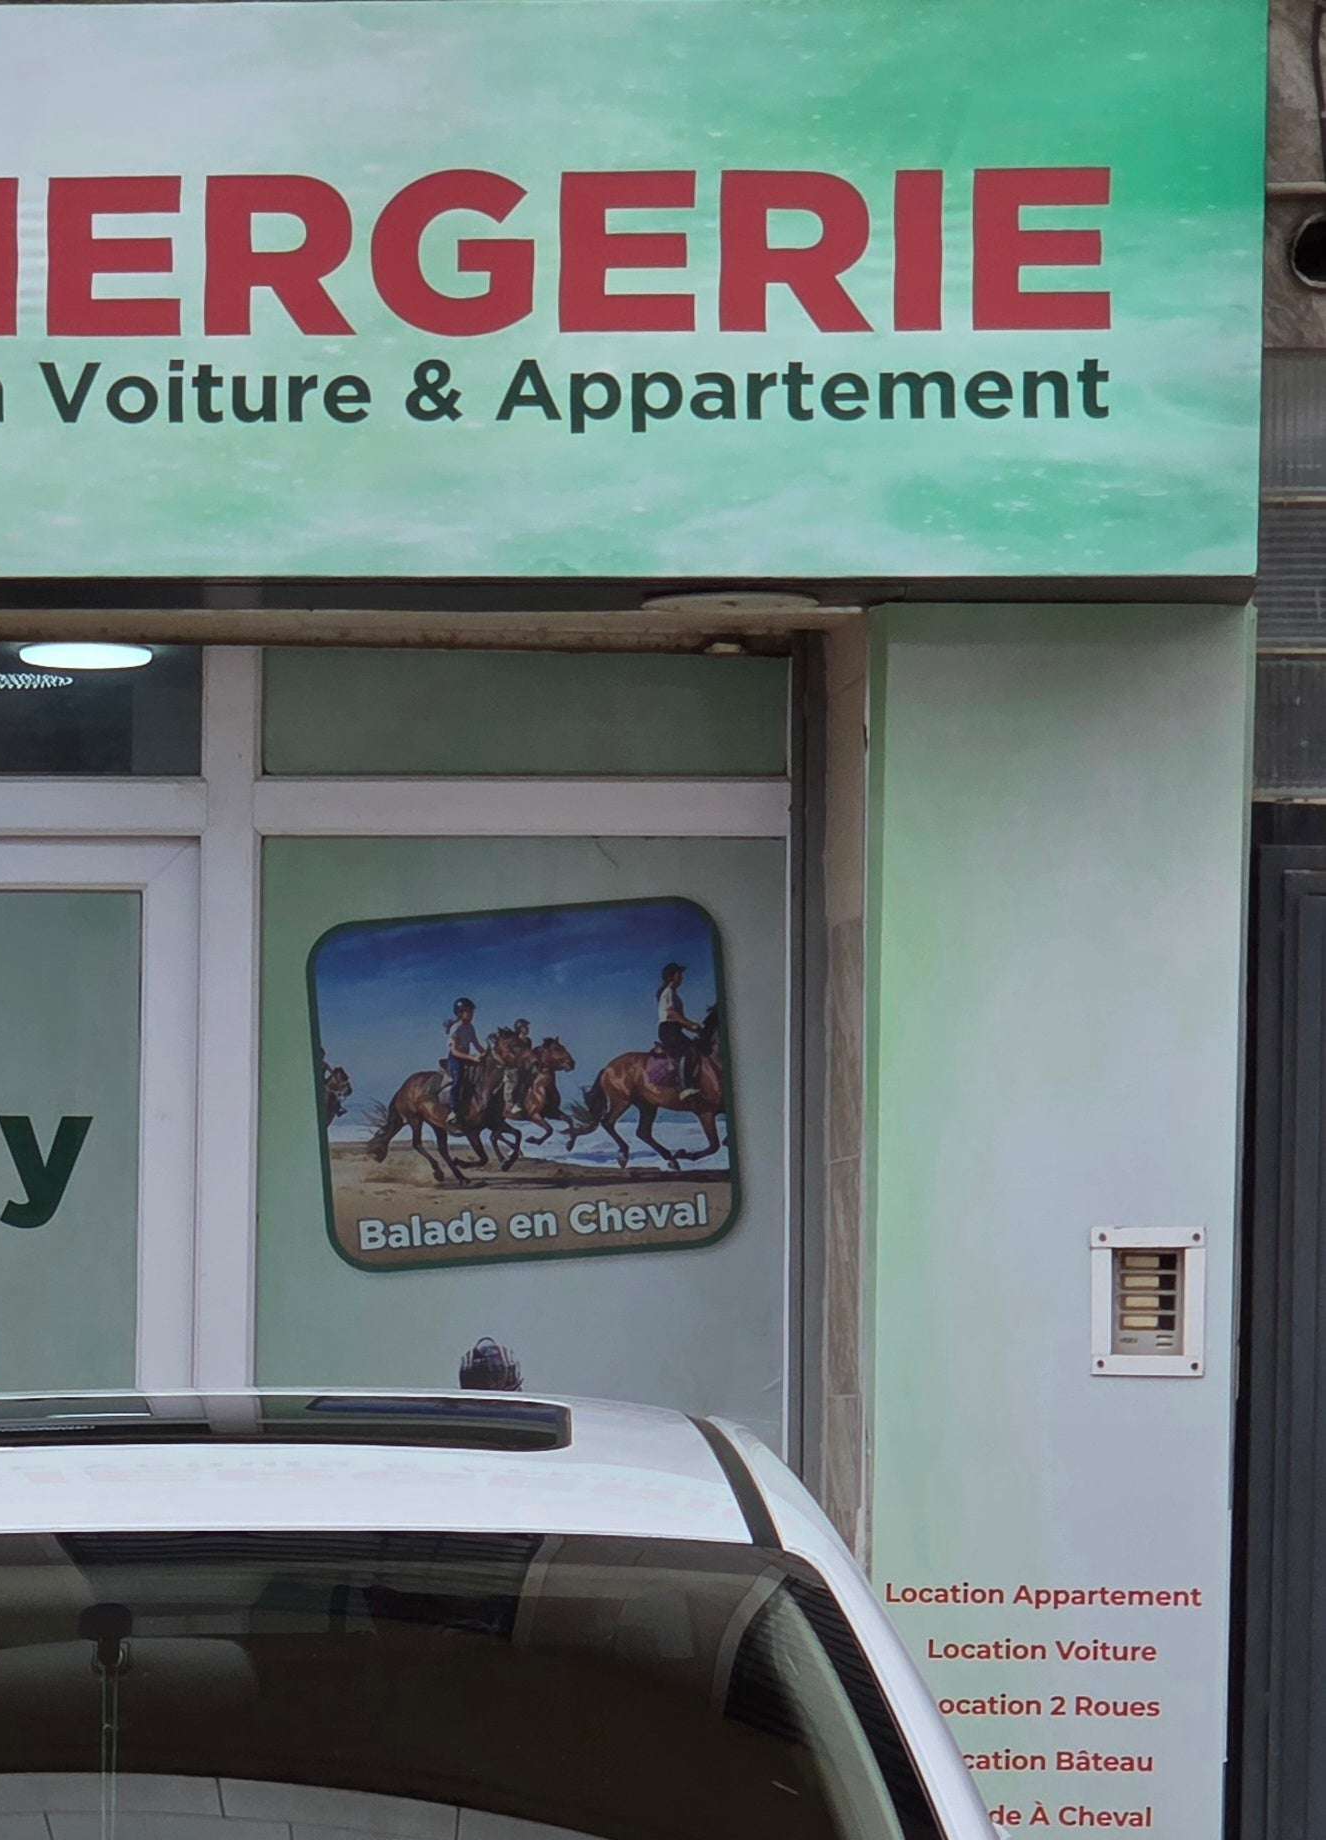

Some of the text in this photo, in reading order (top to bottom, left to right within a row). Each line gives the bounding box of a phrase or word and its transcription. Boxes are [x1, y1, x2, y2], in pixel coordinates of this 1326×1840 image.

[40, 358, 370, 423] Voiture
[405, 358, 462, 422] &
[496, 357, 1110, 433] Appartement
[359, 1194, 708, 1250] Balade en Cheval
[885, 1582, 1202, 1609] Location Appartement
[927, 1638, 1157, 1662] Location Voiture
[938, 1693, 1161, 1717] ocation 2 Roues
[963, 1748, 1153, 1773] cation Bâteau
[1029, 1801, 1050, 1826] À
[1058, 1806, 1152, 1827] Cheval
